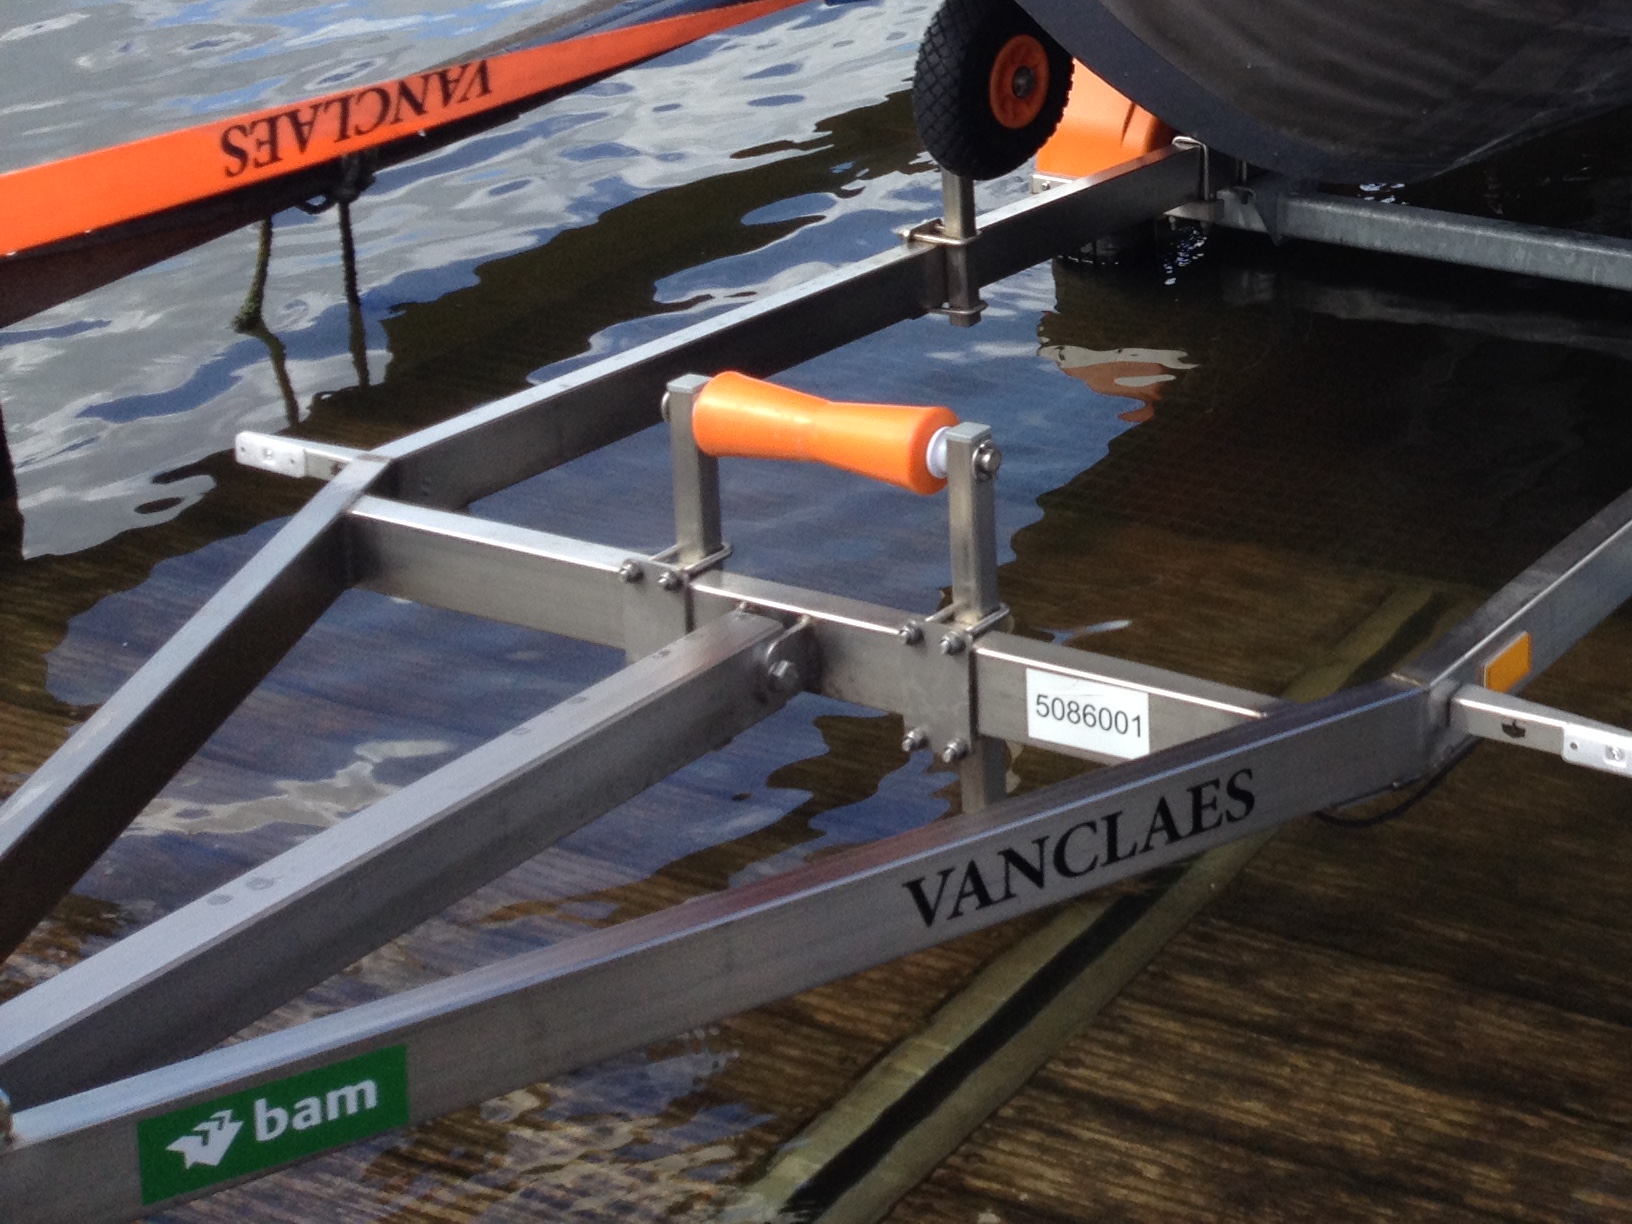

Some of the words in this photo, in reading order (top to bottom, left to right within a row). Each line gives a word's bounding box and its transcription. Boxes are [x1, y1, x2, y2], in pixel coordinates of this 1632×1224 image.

[220, 60, 493, 178] VANCLAES
[1035, 694, 1142, 738] 5086001
[902, 768, 1257, 928] VANCLAES
[255, 1080, 378, 1142] bam
